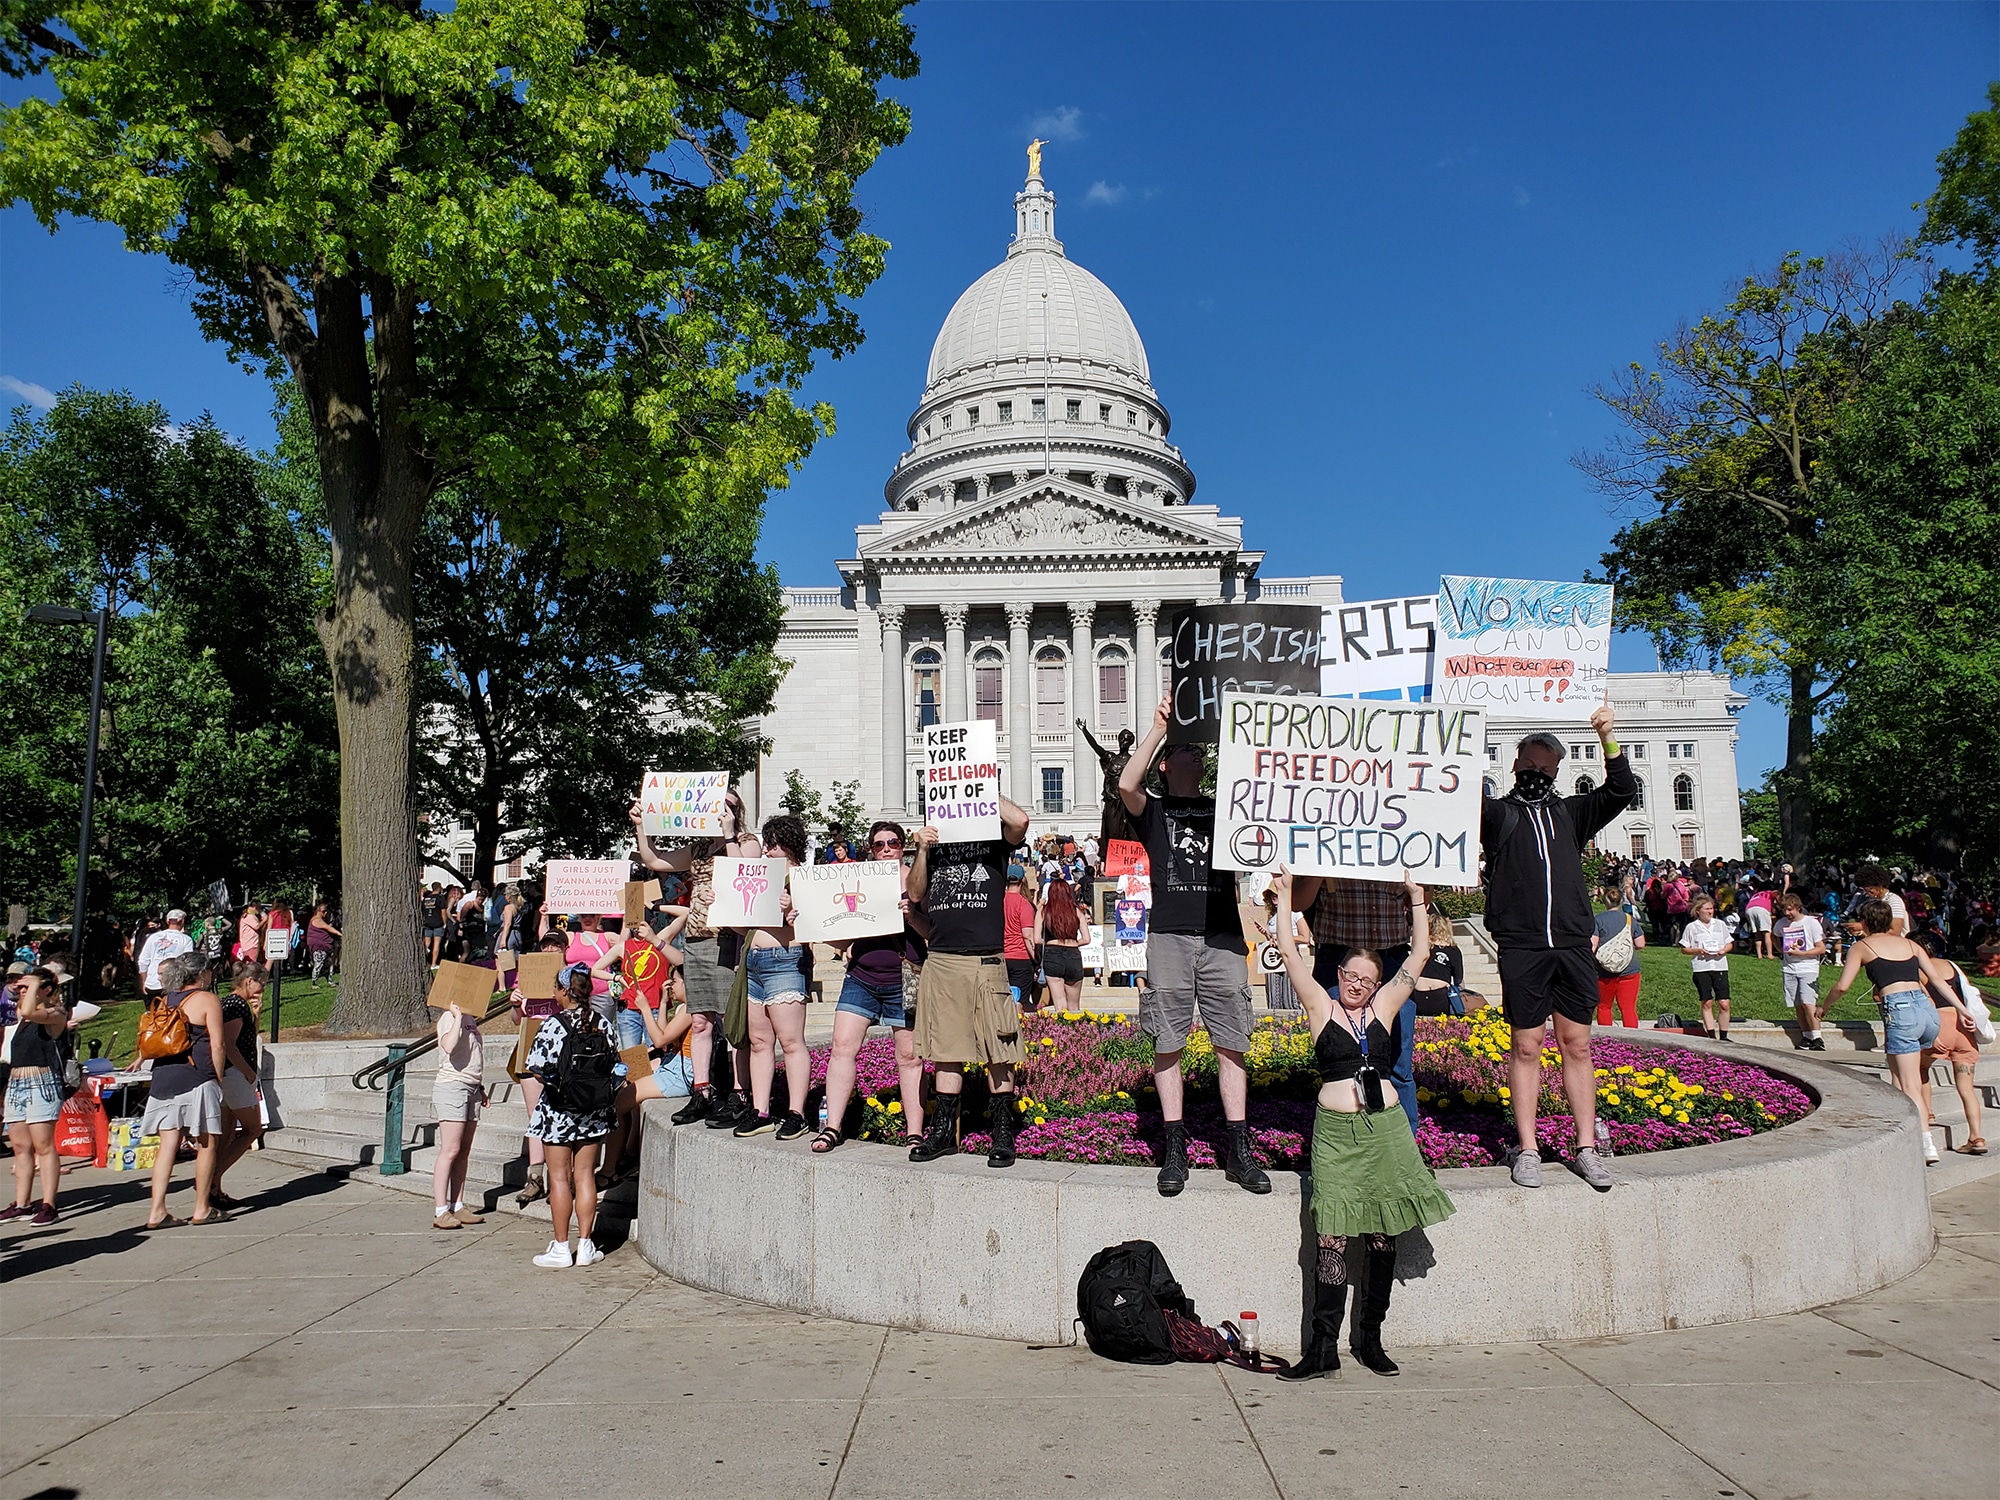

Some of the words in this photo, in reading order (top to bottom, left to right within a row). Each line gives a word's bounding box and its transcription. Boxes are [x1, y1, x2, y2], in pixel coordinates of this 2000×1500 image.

[1174, 617, 1321, 668] CHERISH
[1473, 627, 1544, 655] CAN
[1512, 661, 1543, 671] ever
[928, 728, 968, 746] KEEP
[1230, 701, 1480, 756] REPRODUCTIVE
[928, 747, 966, 764] YOUR
[929, 763, 997, 783] RELIGION
[1255, 750, 1393, 788] FREEDOM
[1407, 761, 1460, 793] IS
[648, 775, 658, 788] A
[664, 774, 727, 789] WOMAN'S
[665, 789, 706, 802] BODY
[929, 785, 957, 801] OUT
[965, 783, 984, 797] OF
[646, 802, 656, 814] A
[661, 800, 721, 814] WOMAN'S
[928, 802, 997, 820] POLITICS
[1229, 778, 1407, 830] RELIGIOUS
[656, 816, 706, 829] CHOICE
[1115, 844, 1127, 854] I'M
[1289, 825, 1467, 872] FREEDOM
[562, 866, 590, 874] GIRLS
[593, 866, 615, 874] JUST
[738, 863, 768, 877] RESIST
[793, 866, 811, 880] MY
[812, 864, 847, 881] BODY,
[847, 862, 862, 878] MY
[862, 861, 899, 876] CHOICE
[556, 877, 592, 885] WANNA
[595, 877, 620, 885] HAVE
[550, 900, 586, 908] HUMAN
[589, 900, 618, 908] RIGHT
[955, 893, 989, 901] THAN
